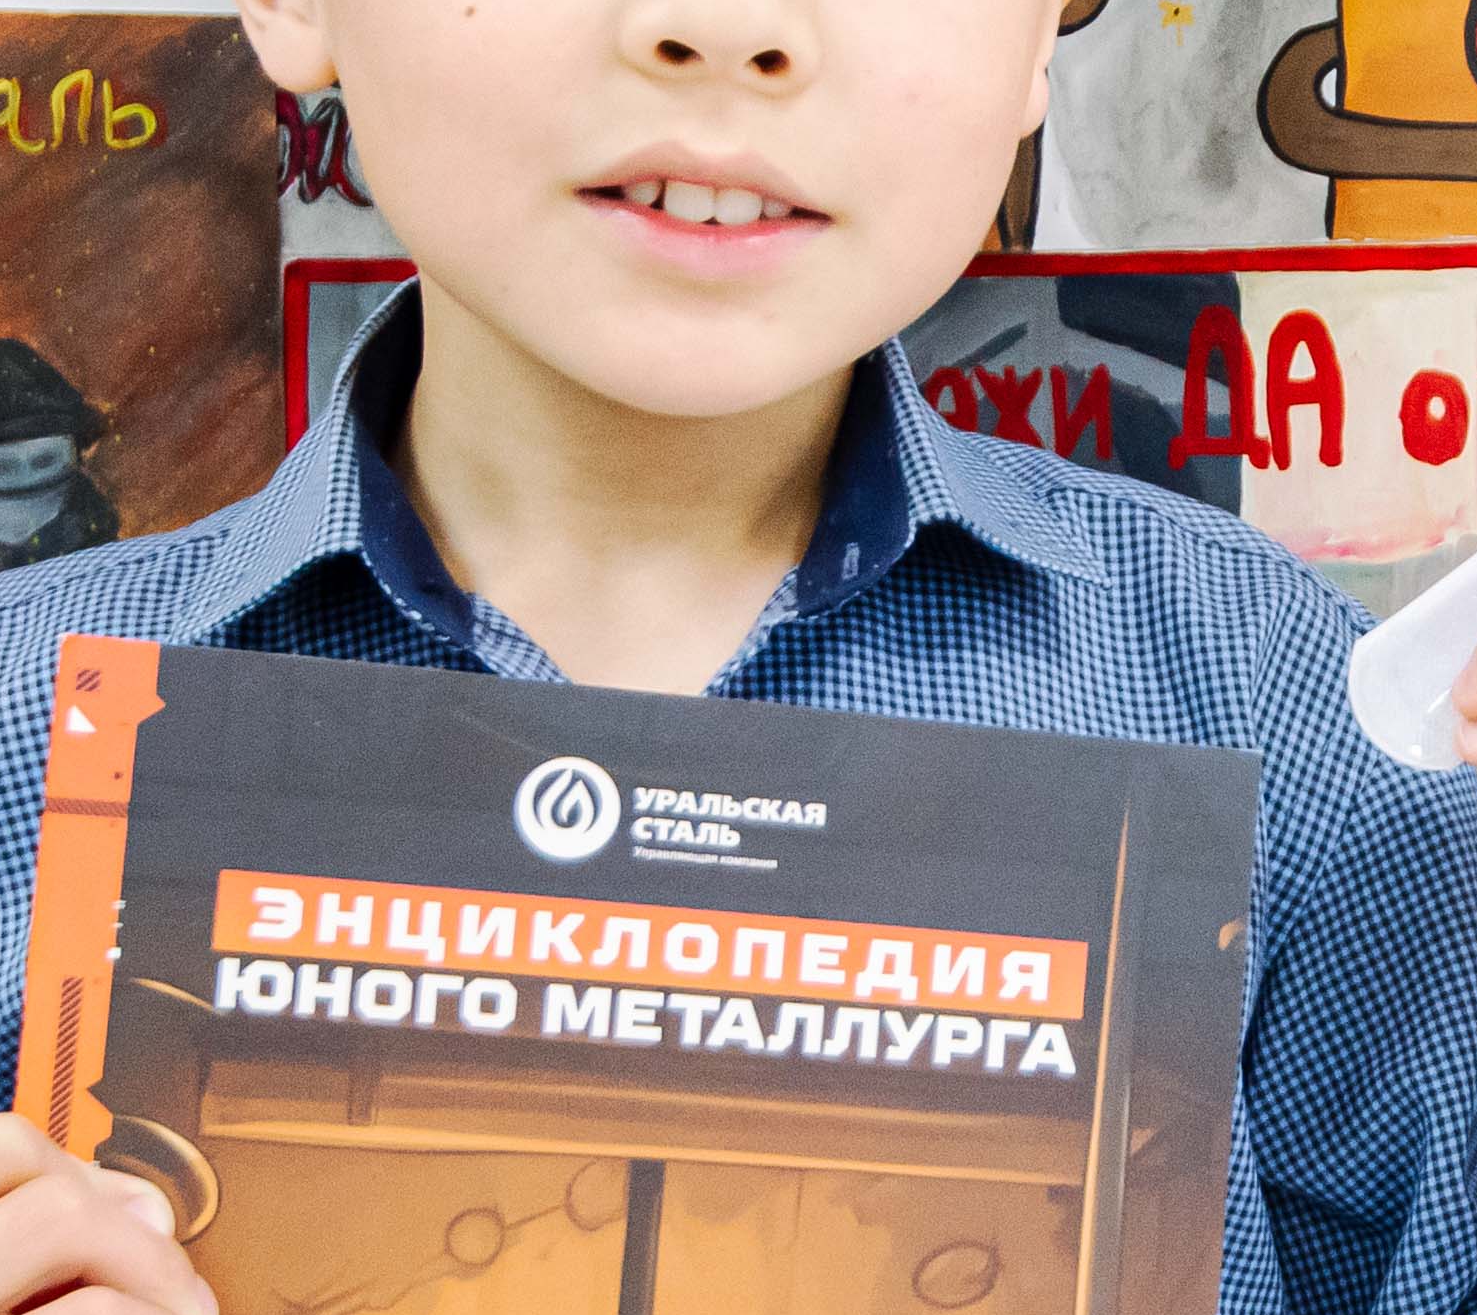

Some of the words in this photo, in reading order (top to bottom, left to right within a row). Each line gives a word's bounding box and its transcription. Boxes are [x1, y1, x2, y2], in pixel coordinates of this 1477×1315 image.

[1167, 302, 1347, 471] ДА
[631, 817, 742, 847] СТАЛЬ
[632, 786, 828, 827] УРАЛЬСКАЯ
[248, 882, 1053, 1006] ЭНЦИКЛОПЕДИЯ
[214, 954, 520, 1038] ЮНОГО
[540, 980, 1078, 1079] МЕТАЛЛУРГА
